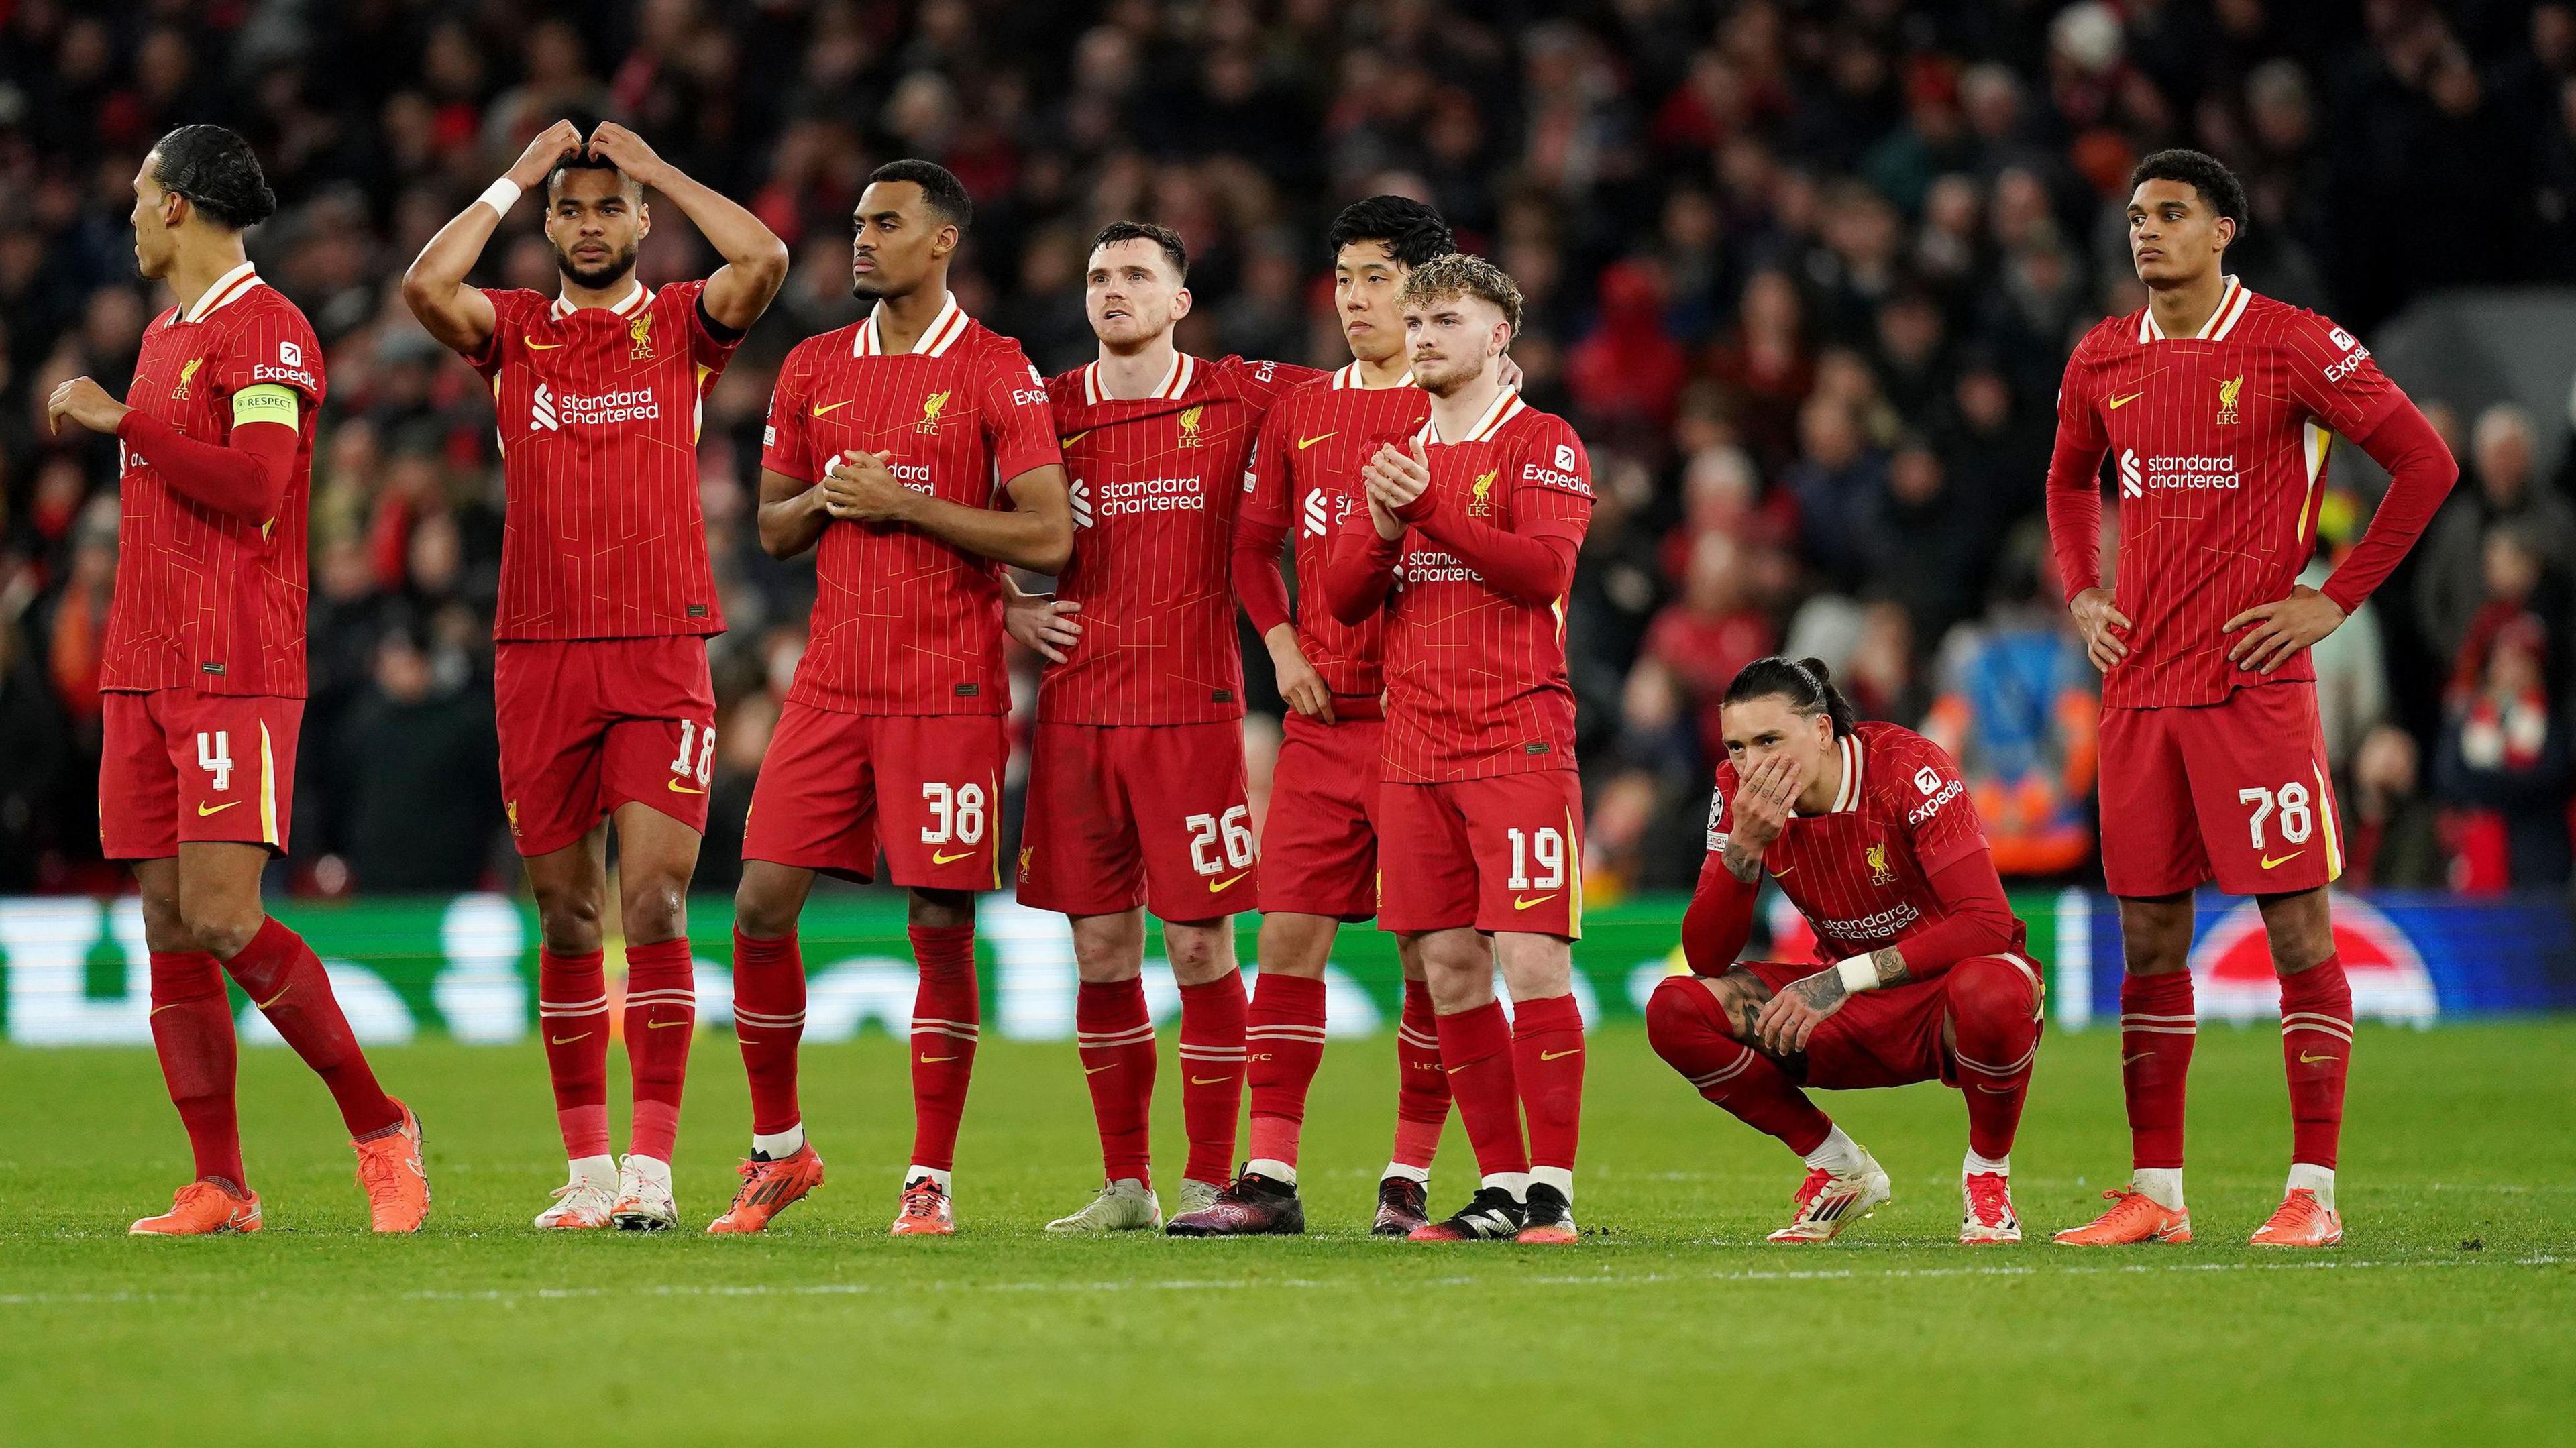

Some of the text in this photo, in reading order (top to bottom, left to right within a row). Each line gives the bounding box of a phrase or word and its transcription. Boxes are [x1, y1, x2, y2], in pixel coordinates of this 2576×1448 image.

[247, 396, 292, 410] RESPECT
[561, 386, 652, 411] standard
[561, 402, 659, 425] chartered
[2147, 453, 2233, 472] standard
[1100, 474, 1200, 500] standard
[1522, 463, 1592, 496] Expedia
[2149, 471, 2239, 489] chartered
[1101, 492, 1205, 516] chartered
[197, 730, 235, 791] 4
[670, 718, 717, 788] 18
[920, 783, 985, 846] 38
[1908, 779, 1964, 824] Expedia
[2239, 781, 2312, 850] 78
[1185, 804, 1254, 877] 26
[1507, 826, 1564, 891] 19
[1822, 901, 1910, 931] standard
[1829, 907, 1919, 940] chartered
